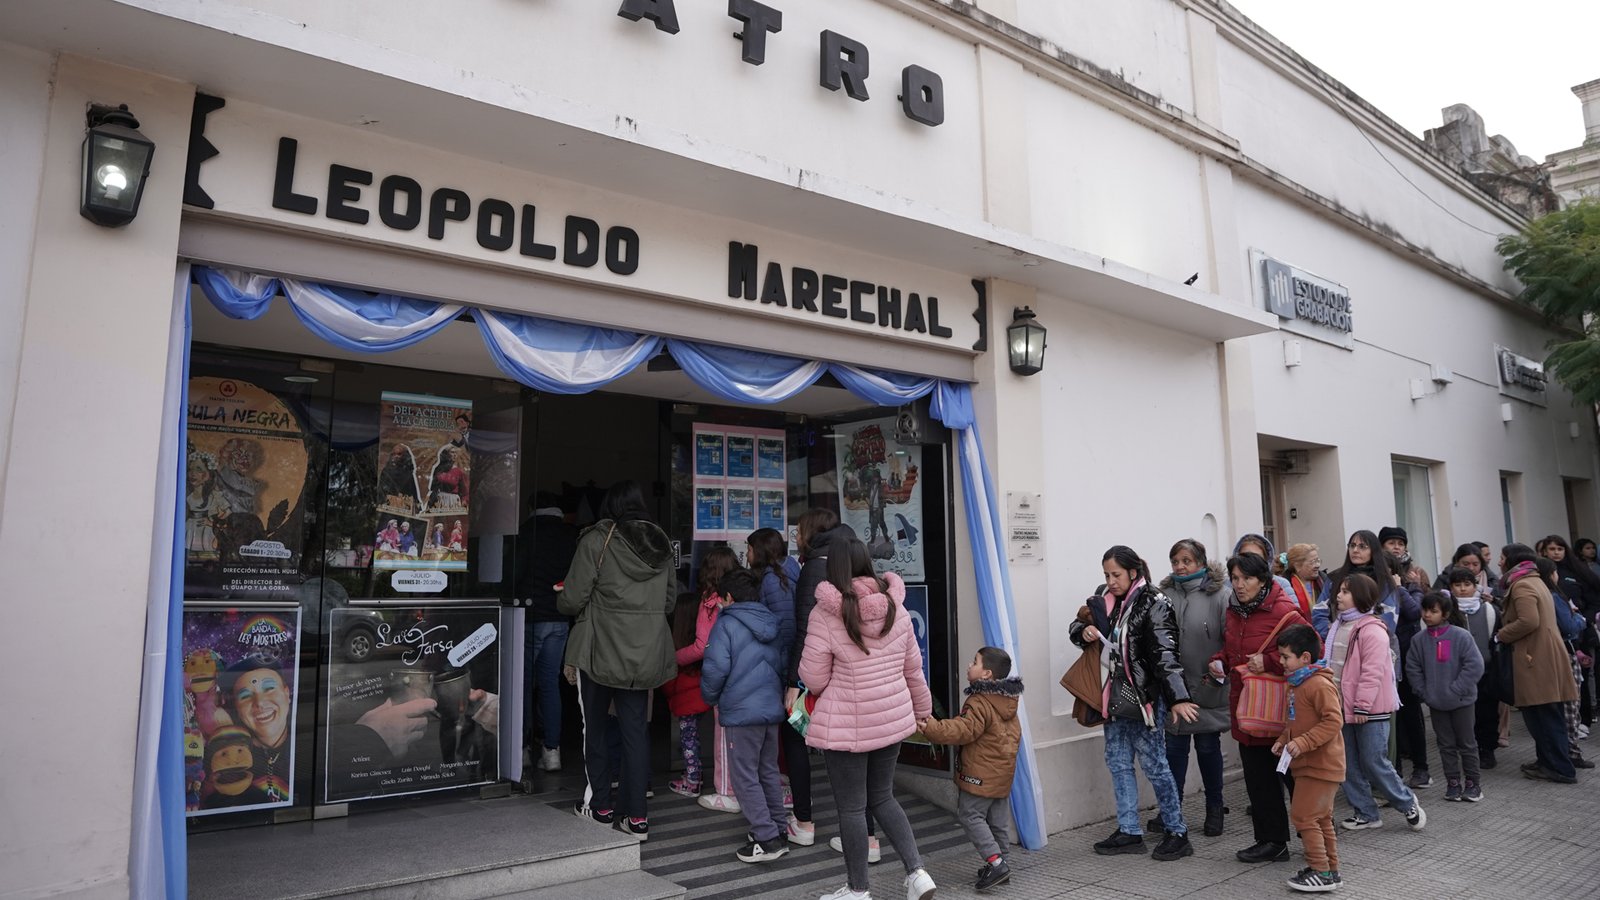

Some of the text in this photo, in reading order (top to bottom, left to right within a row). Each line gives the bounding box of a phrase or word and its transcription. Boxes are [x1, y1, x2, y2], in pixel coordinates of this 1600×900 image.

[272, 136, 953, 338] LEOPOLDO MARECHAL
[1292, 276, 1352, 314] ESTUDIO DE
[232, 409, 290, 429] NEGRA
[393, 405, 452, 419] DEL ACEITE
[392, 416, 455, 429] A LA CACEROLA
[251, 625, 271, 633] BANDA
[238, 631, 288, 645] LES MOSTRES
[376, 619, 454, 665] La Farsa
